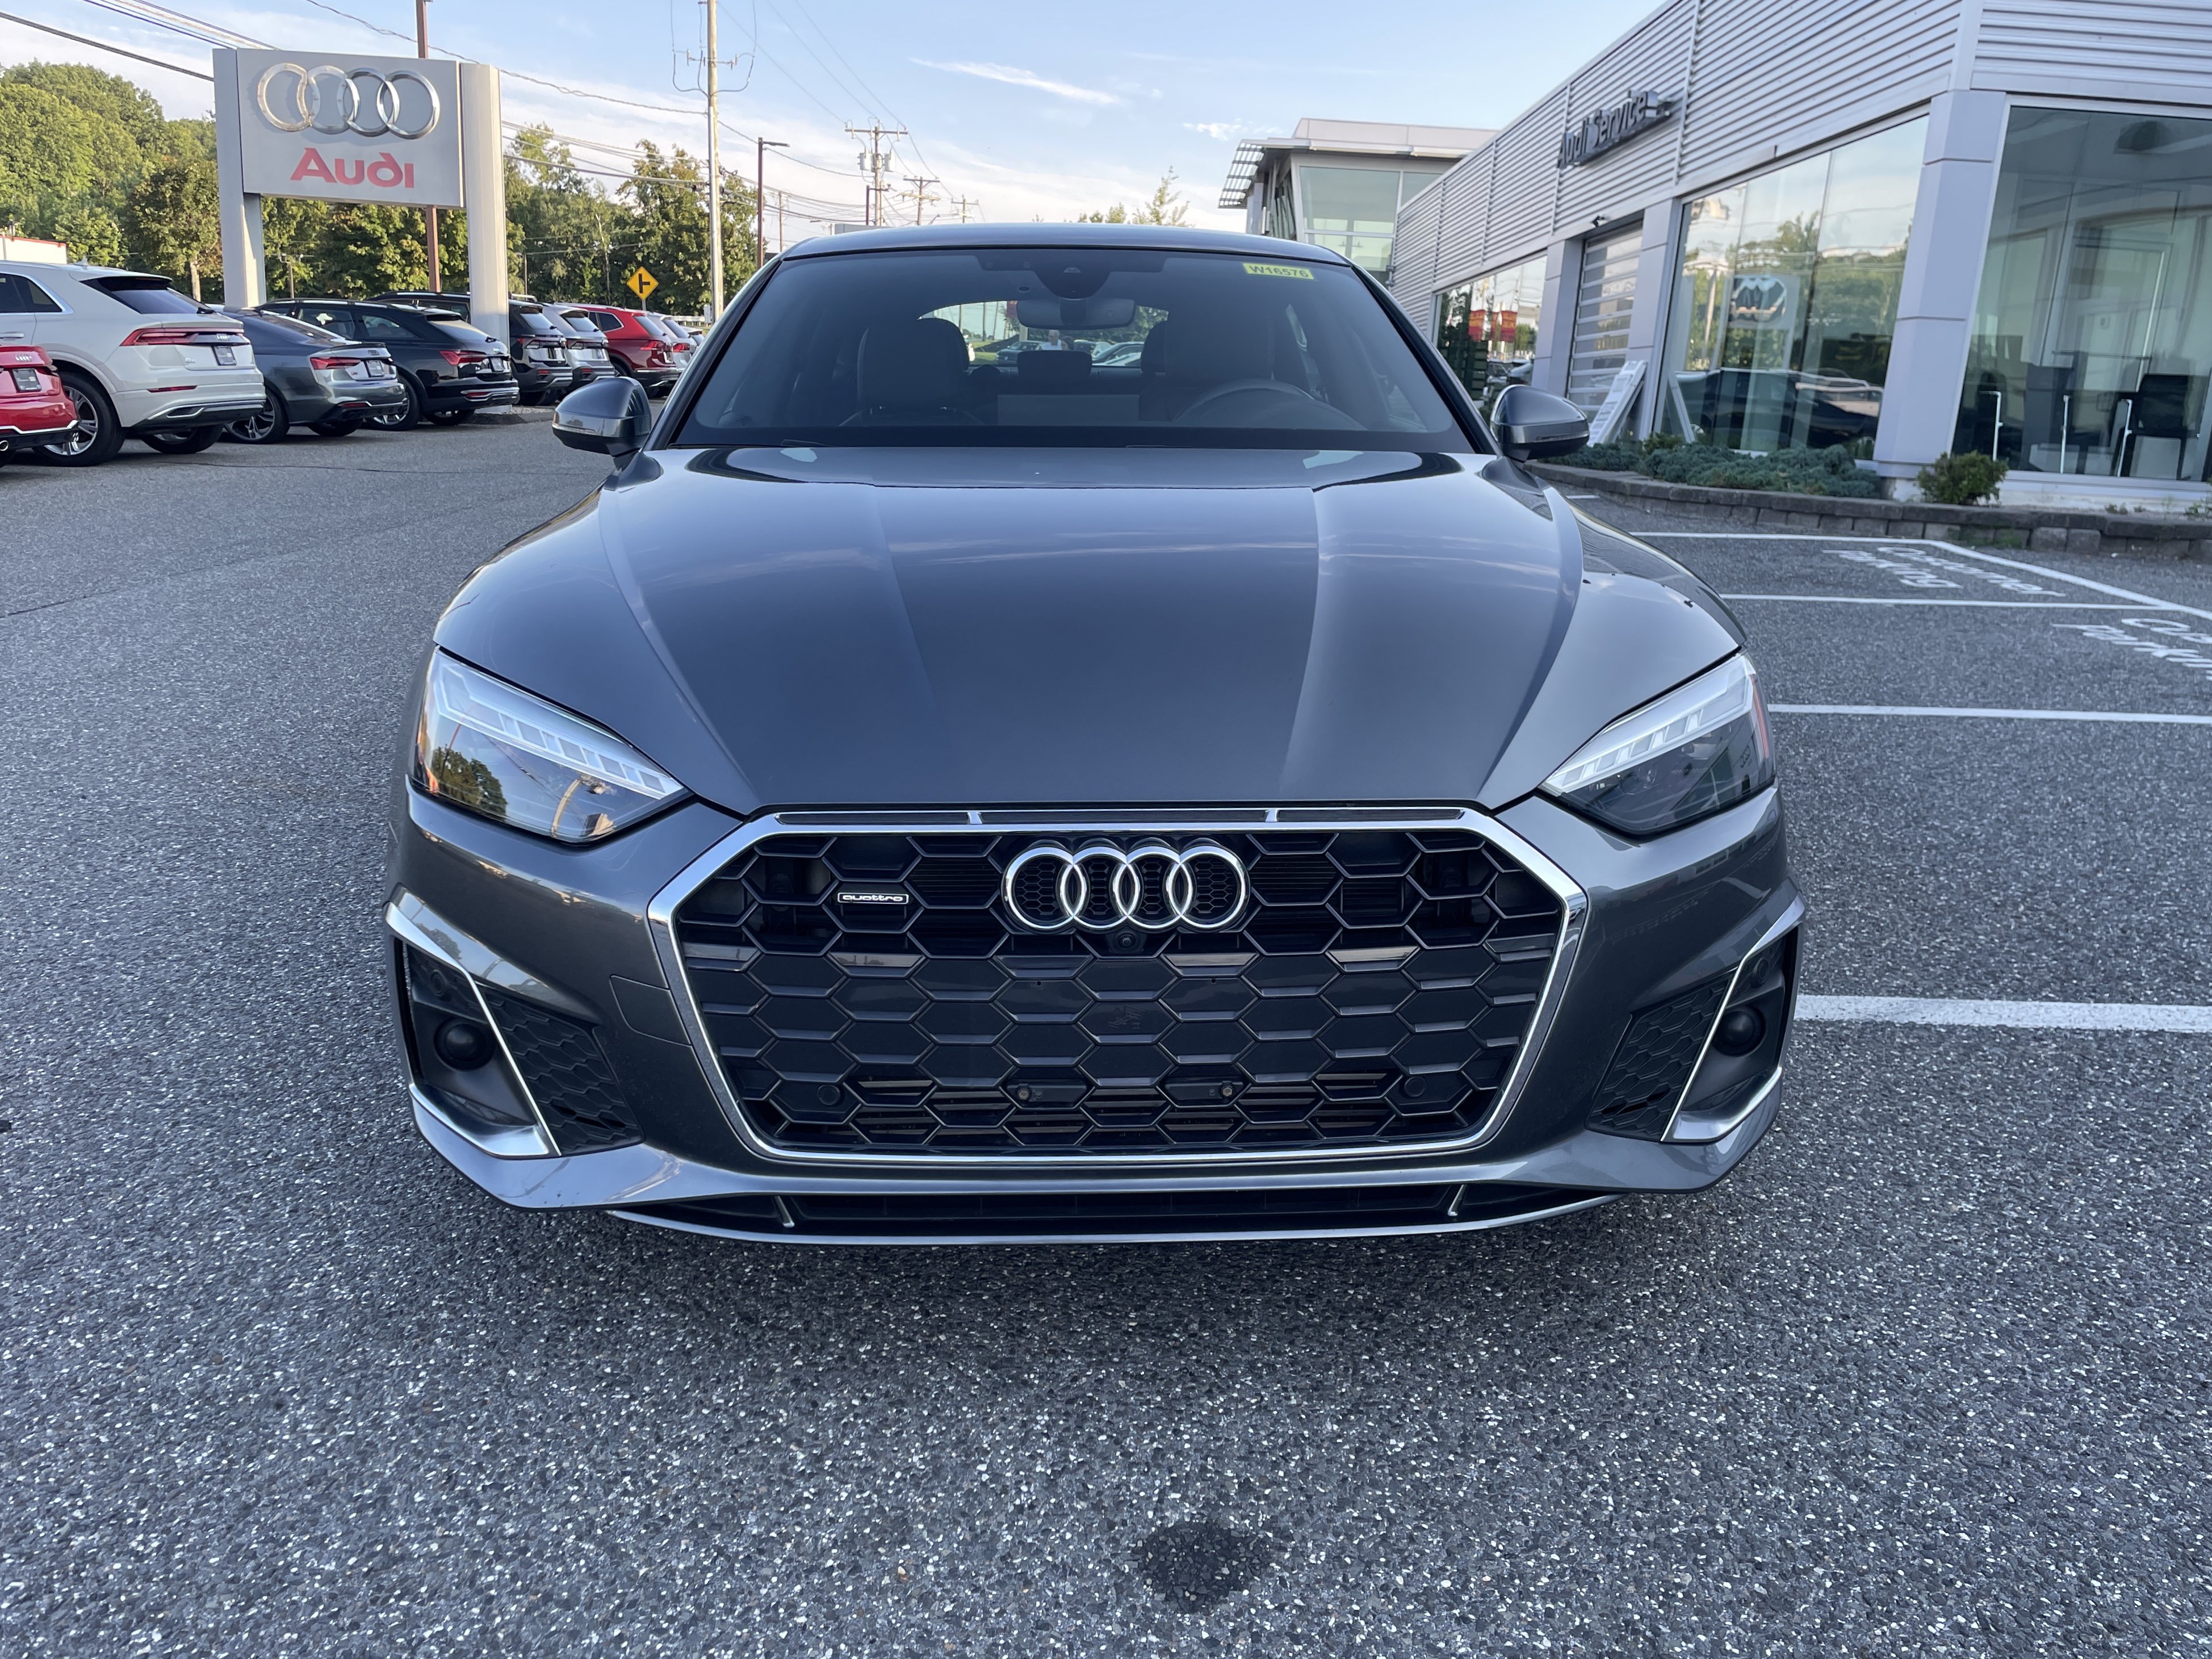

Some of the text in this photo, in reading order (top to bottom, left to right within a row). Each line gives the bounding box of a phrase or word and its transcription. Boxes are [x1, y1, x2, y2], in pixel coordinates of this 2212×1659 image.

[1557, 90, 1651, 168] Audi Service
[290, 147, 414, 188] Audi
[1249, 265, 1309, 278] W16576
